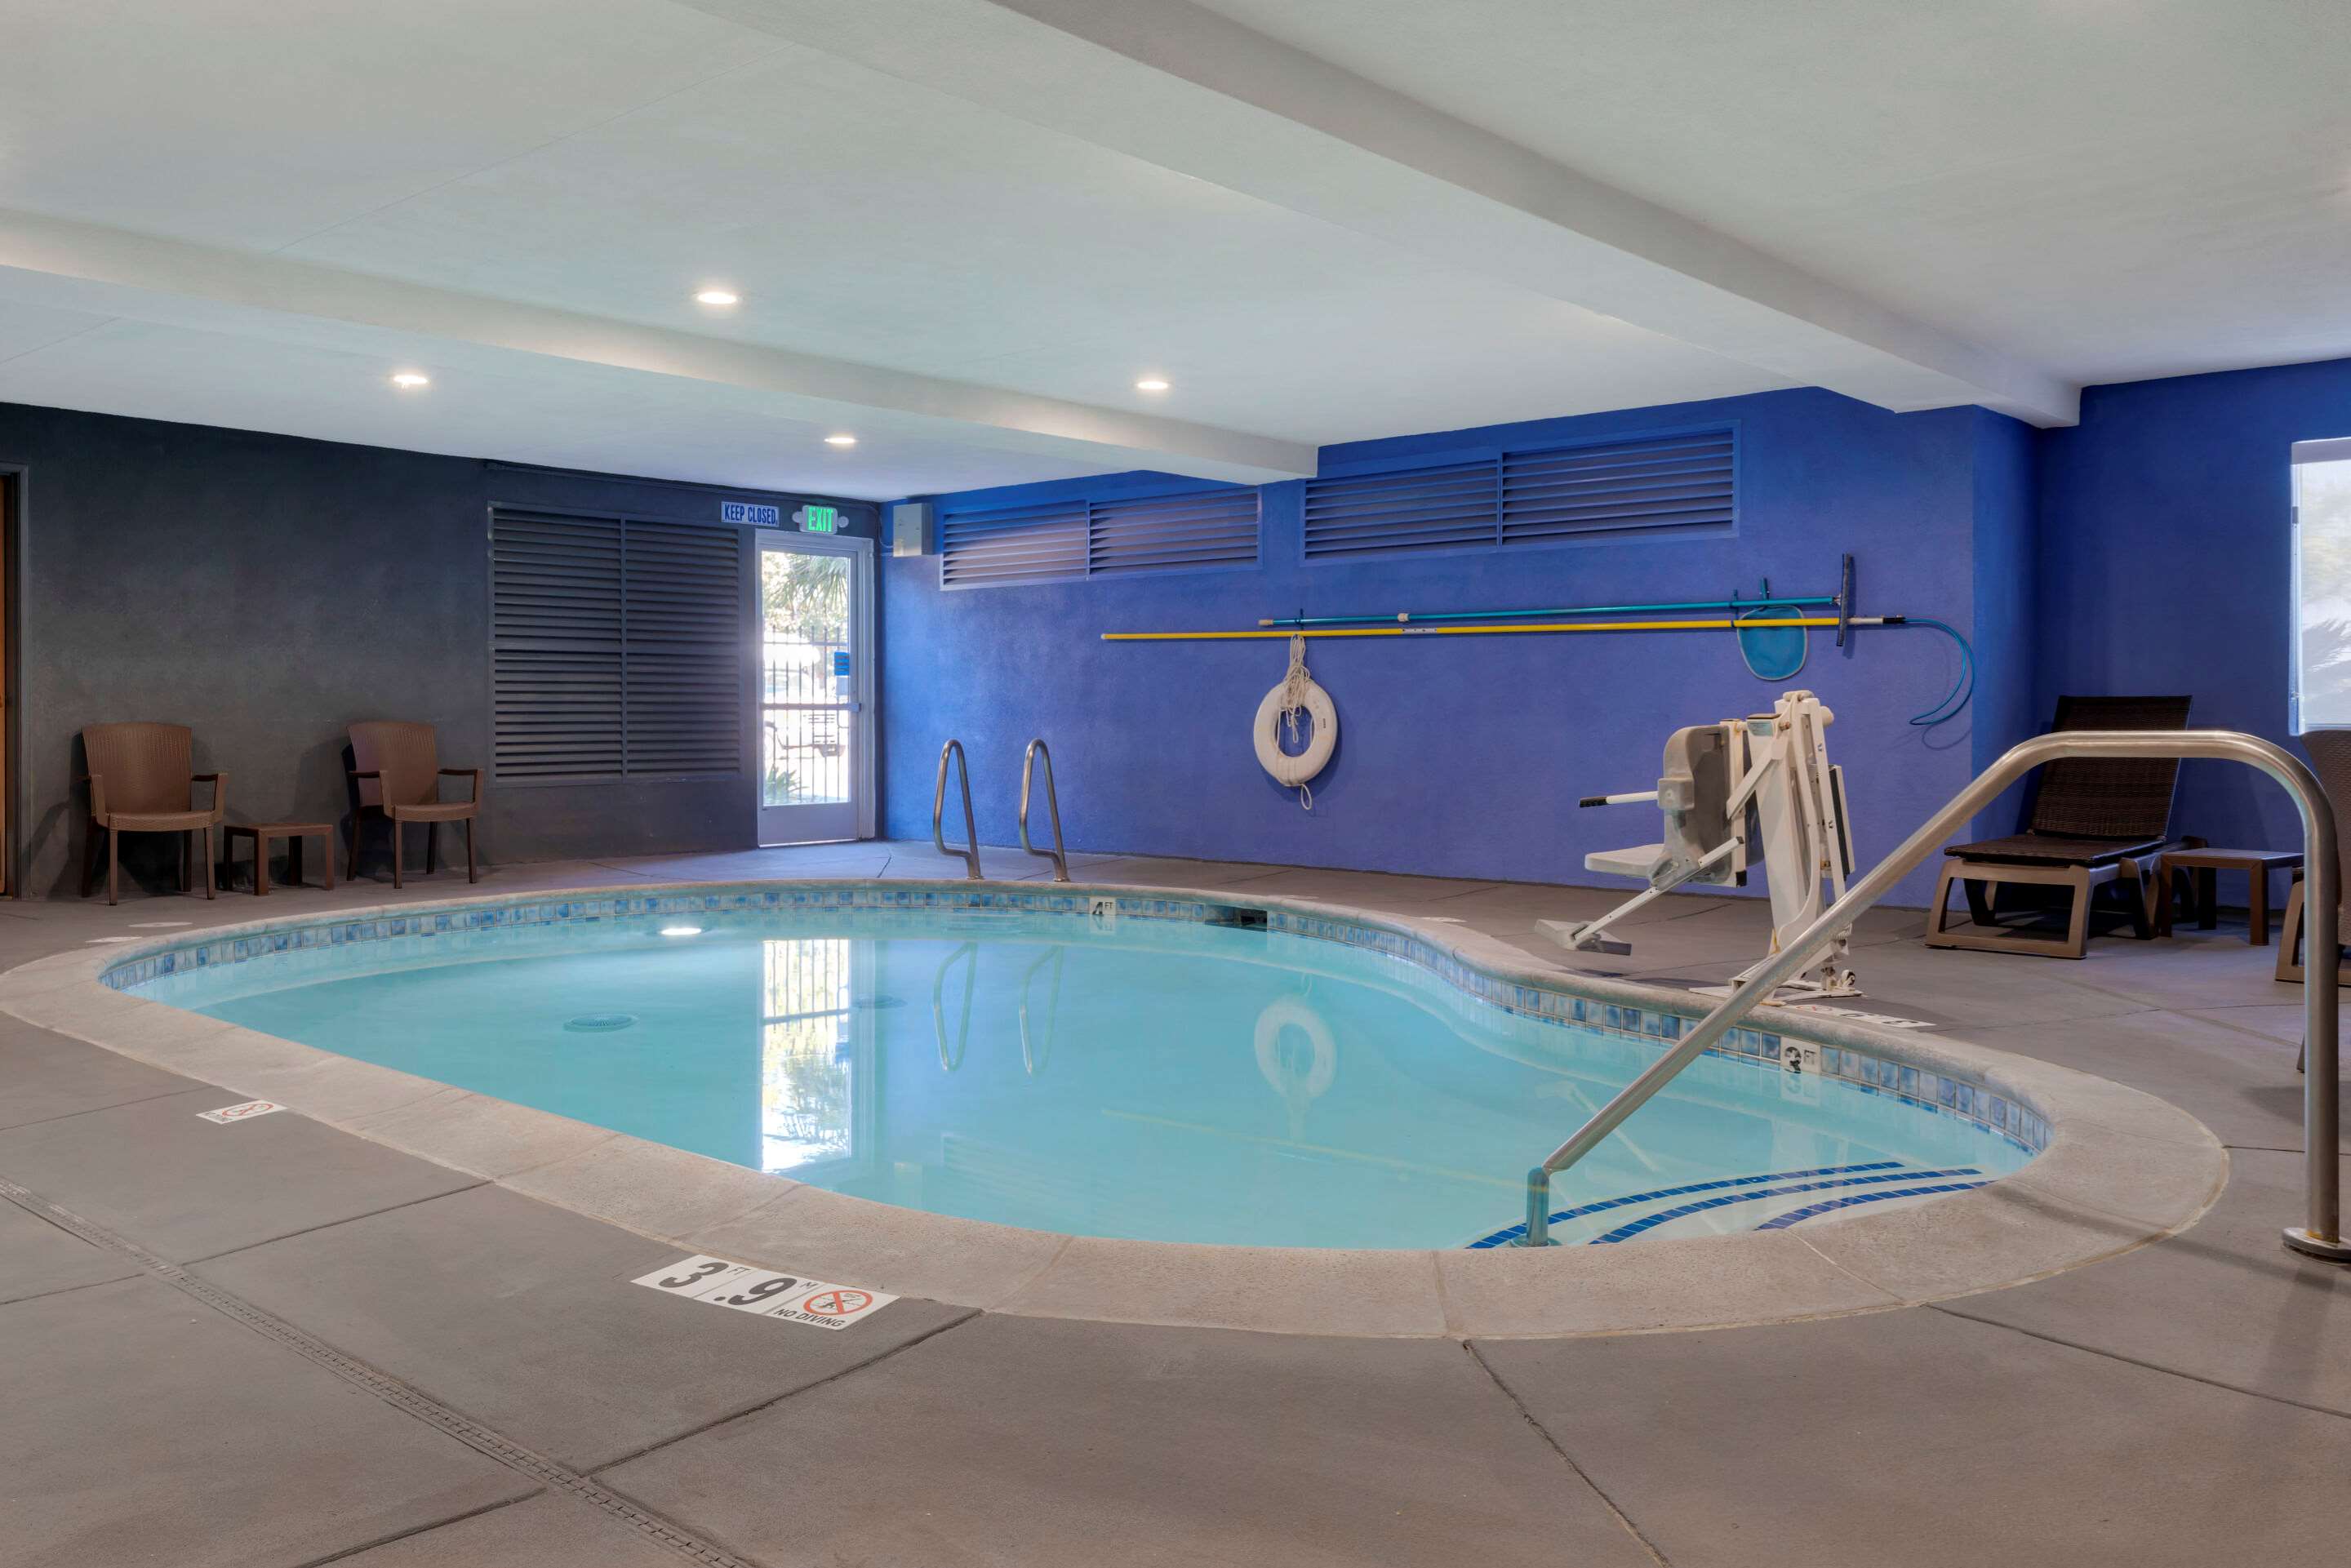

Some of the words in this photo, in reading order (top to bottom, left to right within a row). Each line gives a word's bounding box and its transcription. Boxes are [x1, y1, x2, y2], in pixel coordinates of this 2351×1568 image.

[725, 504, 744, 521] KEEP
[748, 506, 776, 525] CLOSED
[808, 506, 833, 532] EXIT
[1803, 1050, 1816, 1064] FT
[658, 1262, 730, 1288] 3
[728, 1266, 751, 1275] FT
[713, 1277, 798, 1306] .9
[799, 1281, 819, 1289] M
[773, 1308, 798, 1318] NO
[795, 1312, 846, 1328] DIVING
